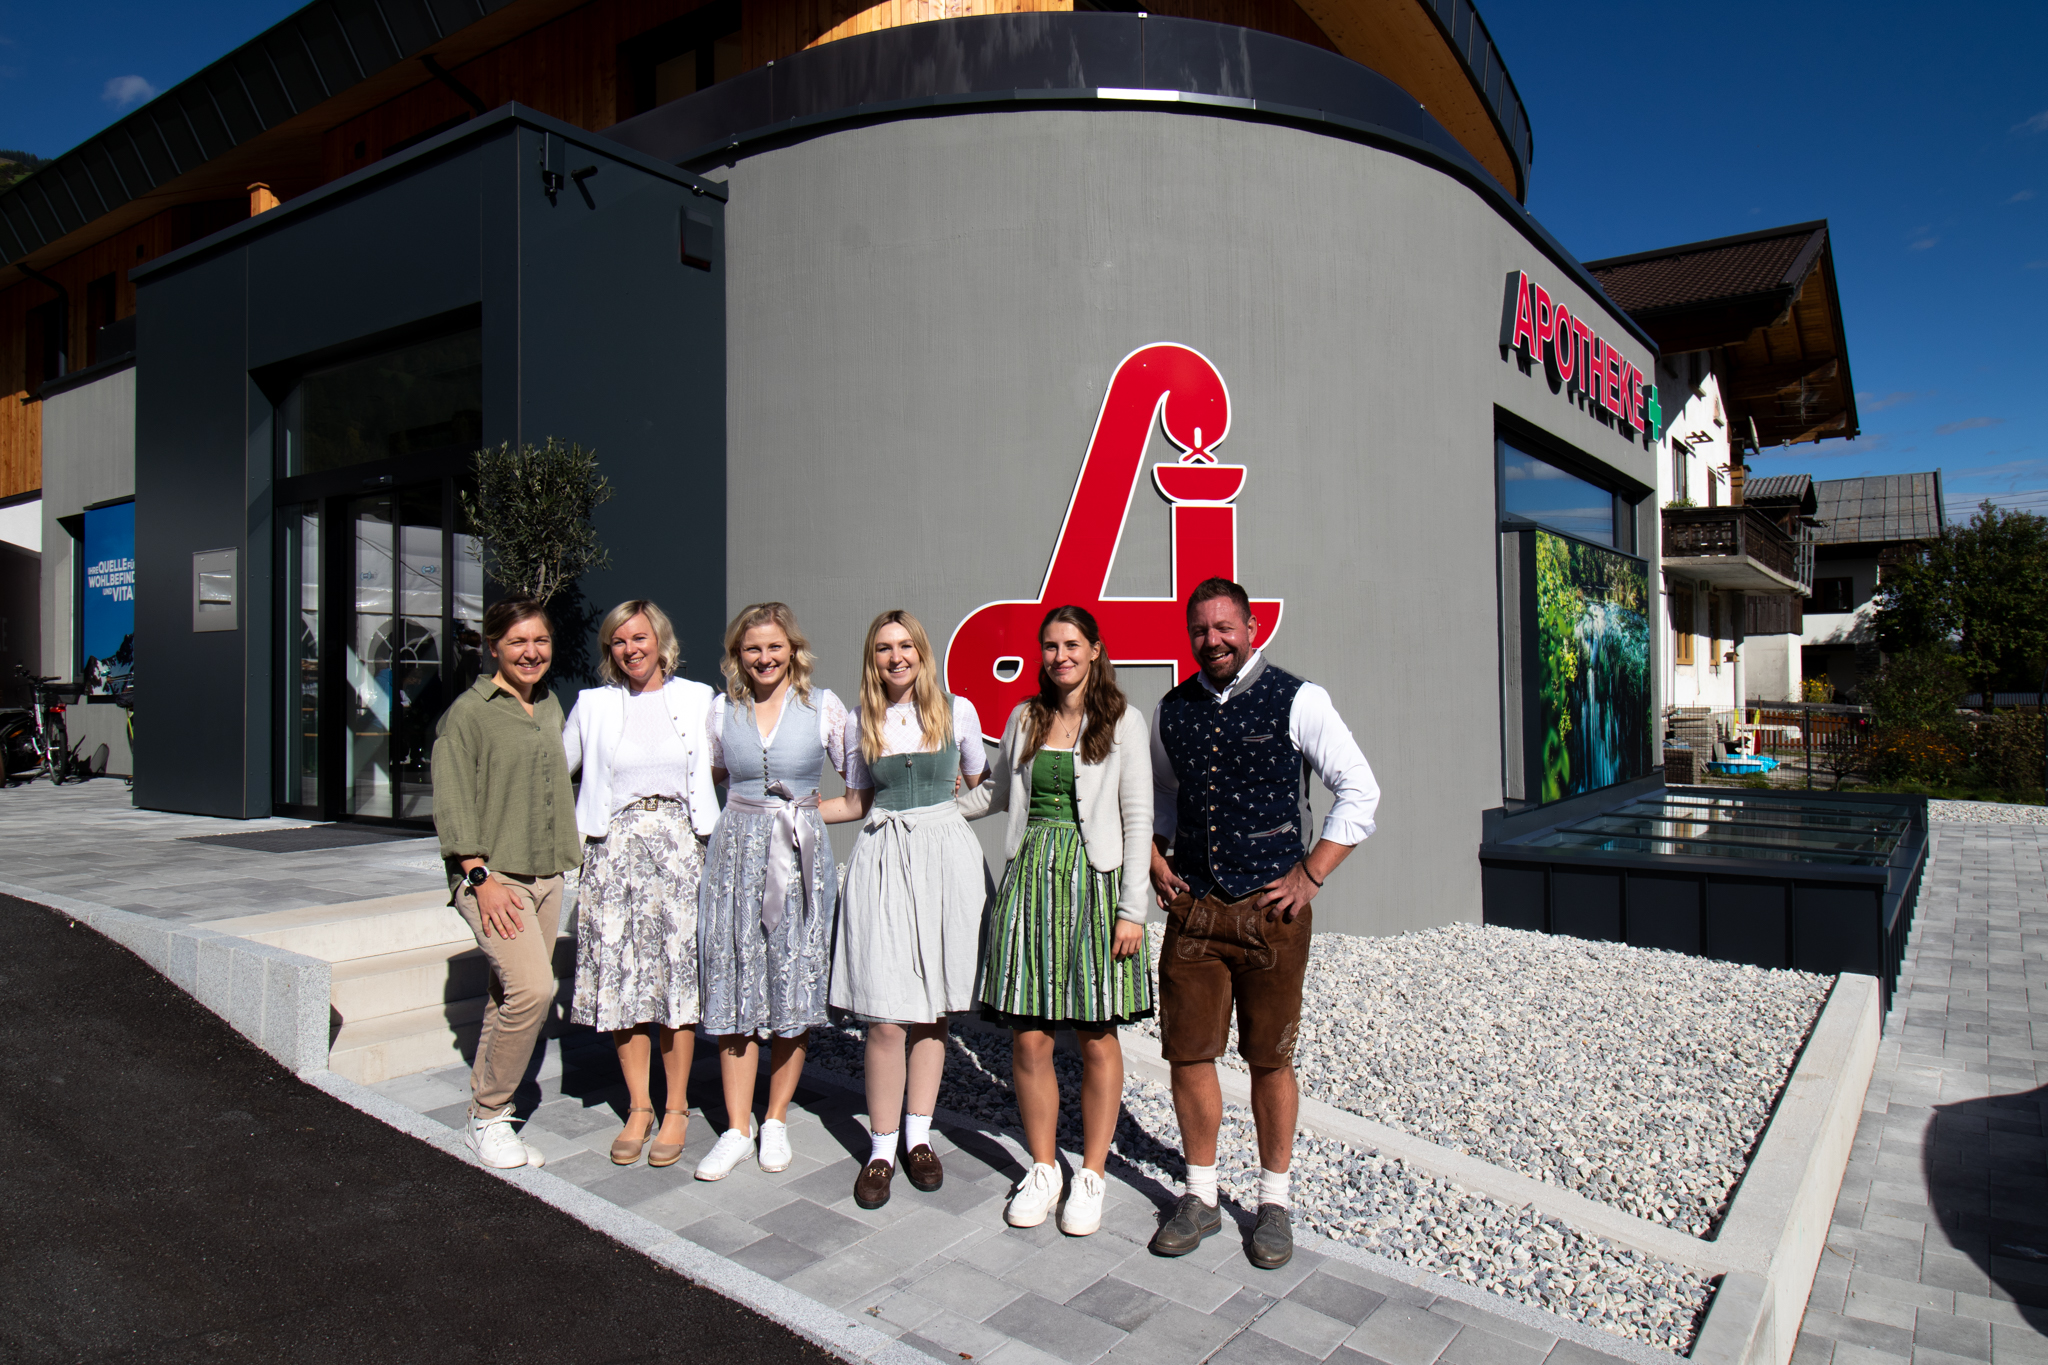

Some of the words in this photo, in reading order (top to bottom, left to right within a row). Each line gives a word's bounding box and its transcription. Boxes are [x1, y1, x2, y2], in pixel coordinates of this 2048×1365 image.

[1512, 269, 1645, 434] APOTHEKE
[87, 566, 99, 575] IHRE
[98, 558, 127, 574] QUELLE
[102, 587, 112, 595] UND
[112, 585, 135, 602] VITA
